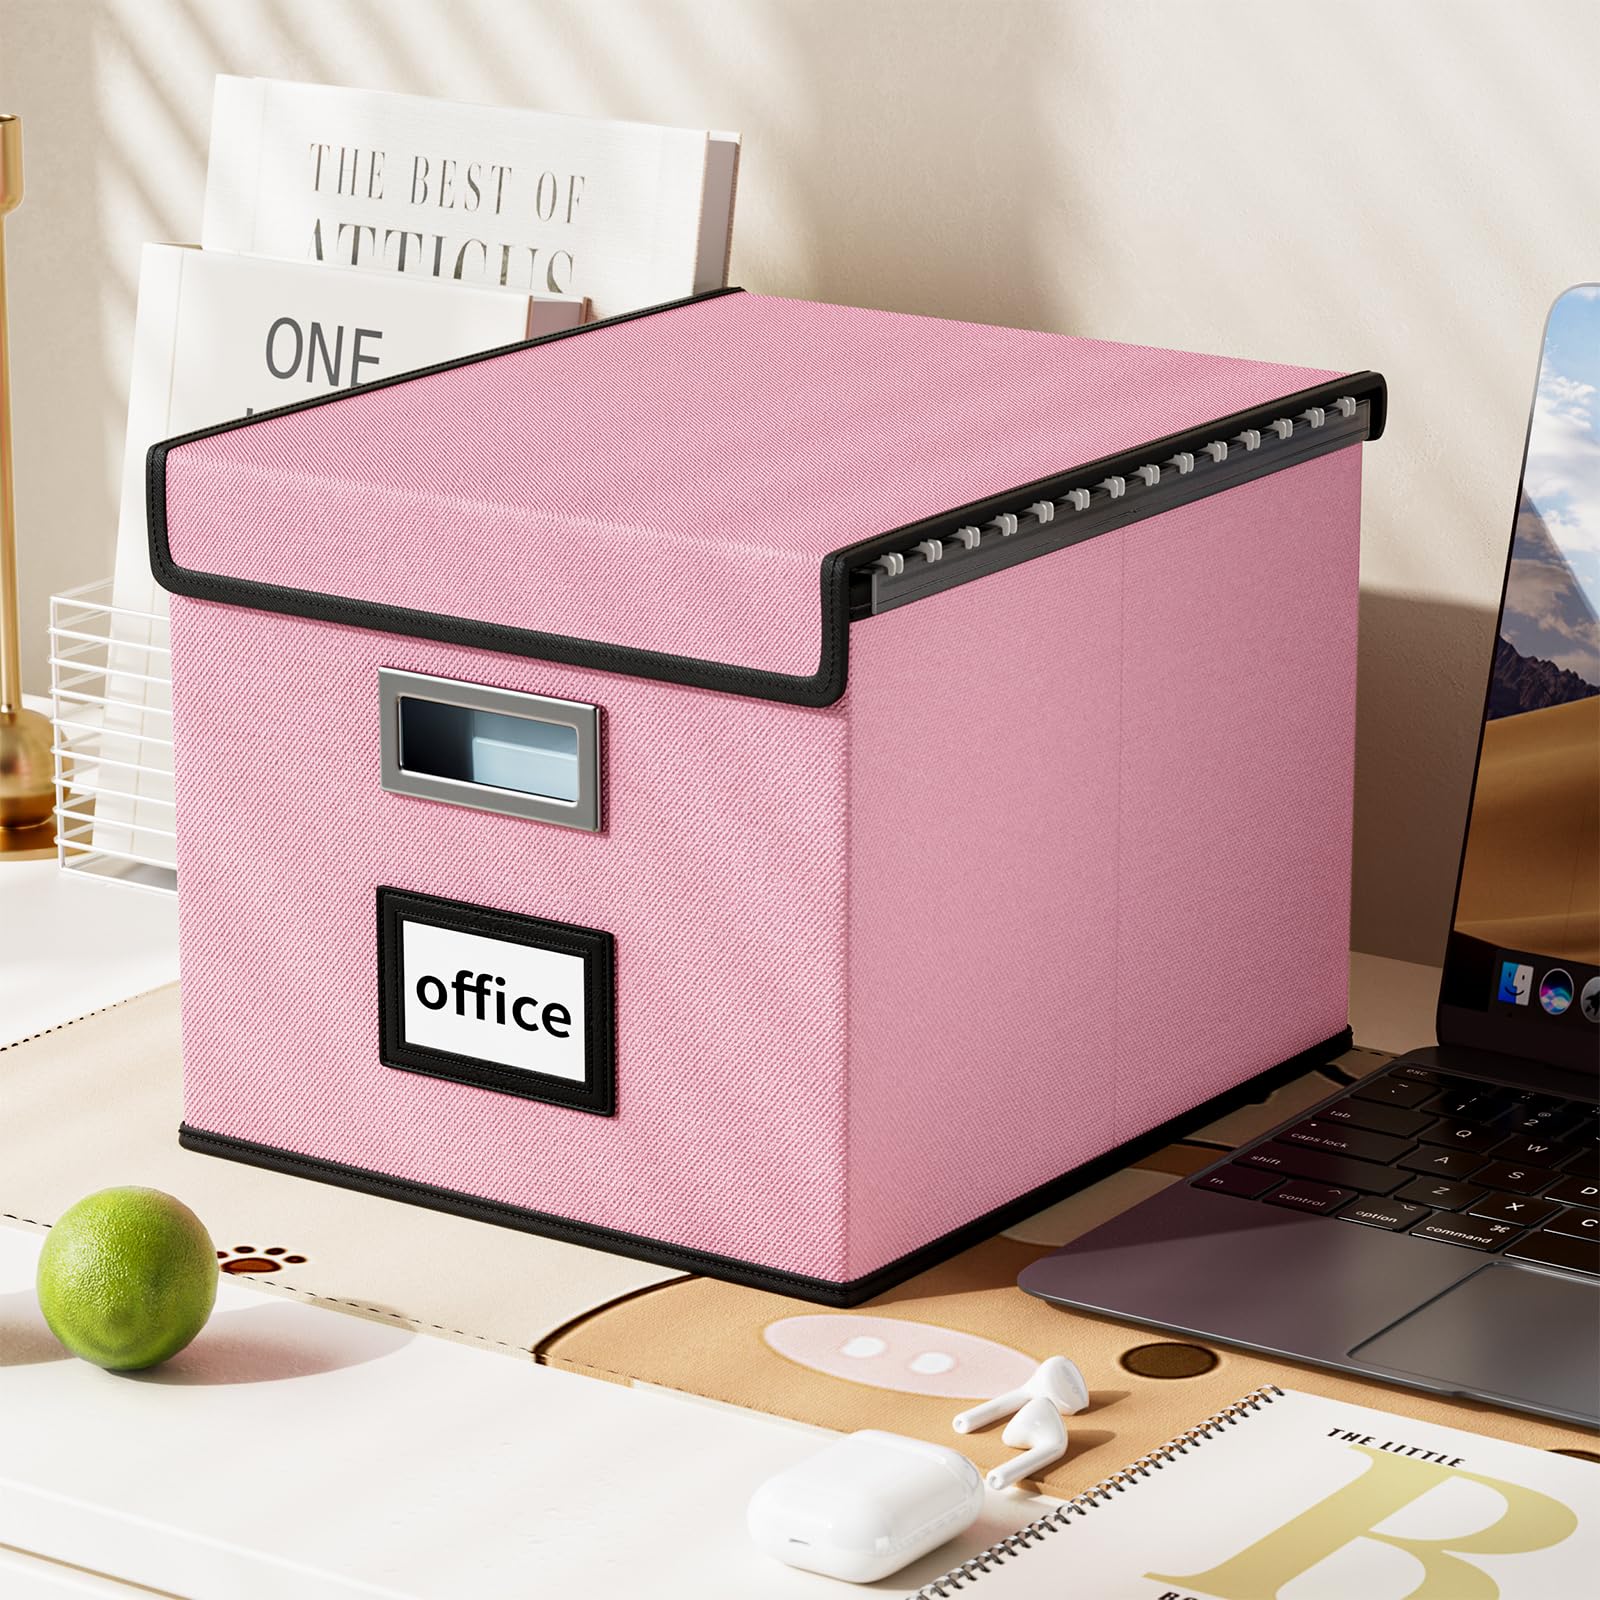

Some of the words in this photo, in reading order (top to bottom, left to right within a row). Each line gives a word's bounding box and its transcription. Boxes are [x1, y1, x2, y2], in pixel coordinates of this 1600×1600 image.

[310, 143, 385, 199] THE
[410, 156, 512, 214] BEST
[536, 171, 586, 223] OF
[266, 317, 383, 388] ONE
[416, 970, 571, 1038] office
[1406, 1068, 1428, 1077] esc
[1329, 1110, 1351, 1119] tab
[1523, 1118, 1539, 1127] 2
[1456, 1130, 1472, 1138] Q
[1291, 1132, 1321, 1144] caps
[1322, 1138, 1349, 1149] lock
[1527, 1144, 1549, 1153] W
[1250, 1154, 1281, 1166] shift
[1434, 1156, 1450, 1164] A
[1508, 1171, 1525, 1180] S
[1209, 1177, 1224, 1185] fn
[1432, 1186, 1450, 1195] Z
[1580, 1186, 1599, 1195] D
[1278, 1193, 1326, 1207] control
[1504, 1202, 1525, 1212] X
[1355, 1209, 1398, 1223] option
[1581, 1218, 1599, 1228] C
[1425, 1225, 1493, 1244] command
[1327, 1427, 1376, 1446] THE
[1379, 1441, 1466, 1468] LITTLE
